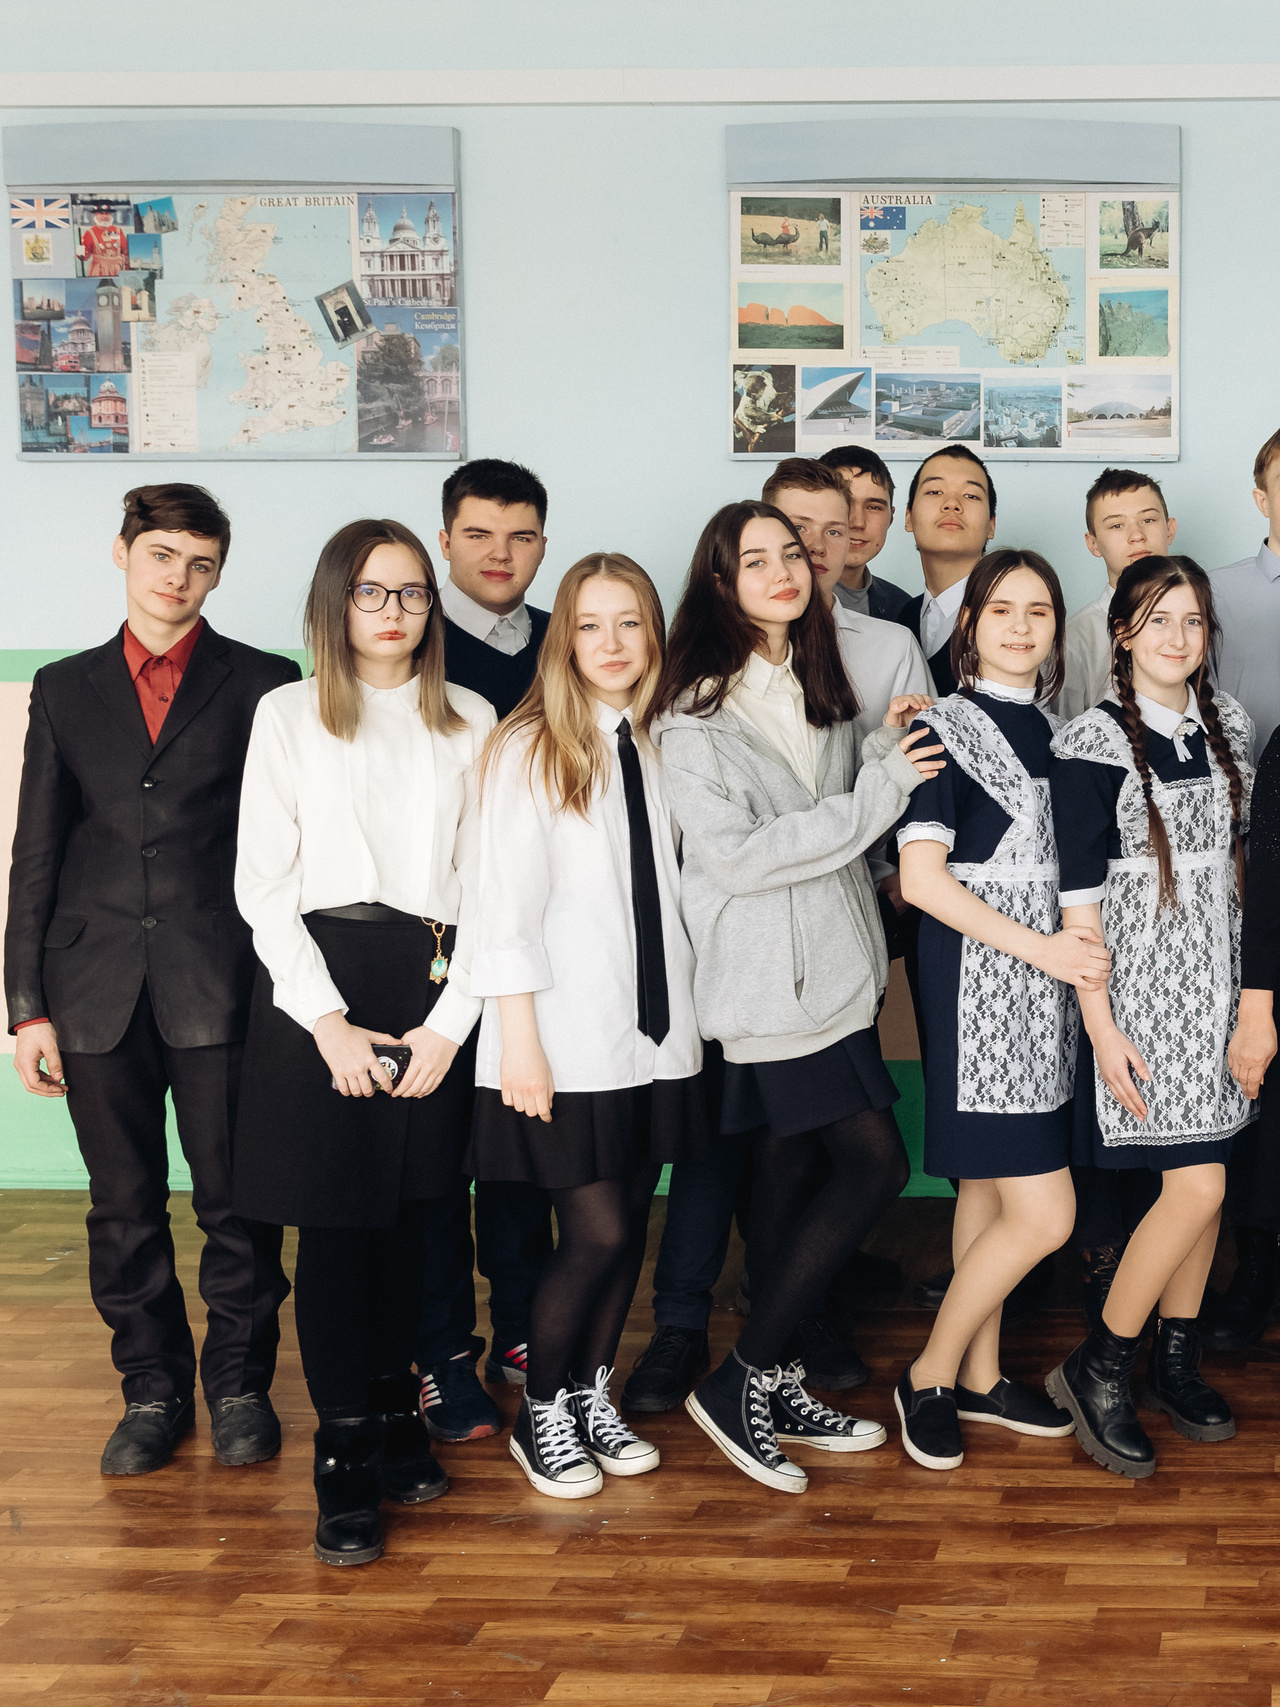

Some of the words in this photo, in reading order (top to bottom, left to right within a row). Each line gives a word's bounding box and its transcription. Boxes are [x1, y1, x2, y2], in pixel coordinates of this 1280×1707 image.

[260, 197, 299, 207] GREAT
[305, 196, 355, 207] BRITAIN
[862, 195, 933, 205] AUSTRALIA
[398, 298, 434, 307] Cathedral
[414, 312, 456, 322] Cambridge
[414, 321, 457, 331] Кембридж
